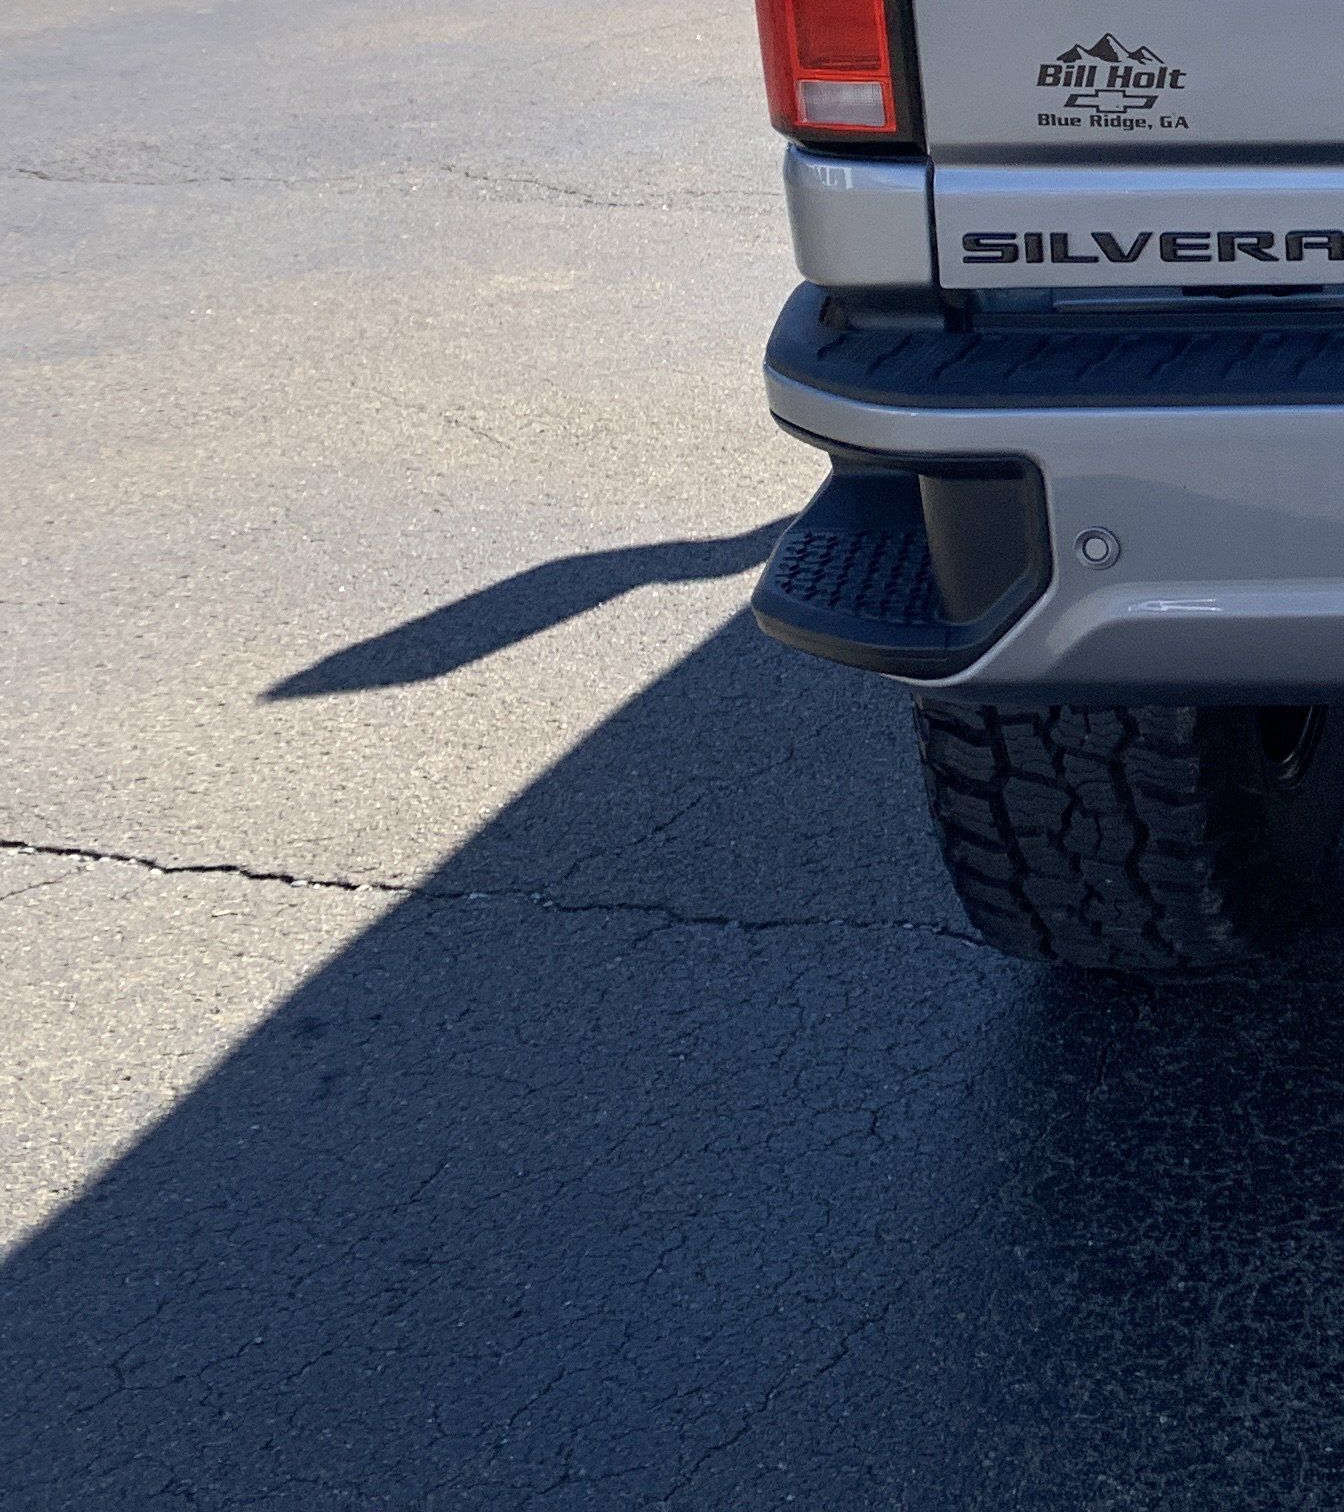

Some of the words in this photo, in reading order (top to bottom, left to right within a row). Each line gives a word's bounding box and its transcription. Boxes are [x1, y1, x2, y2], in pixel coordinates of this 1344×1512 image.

[1036, 63, 1097, 88] Bill
[1106, 65, 1187, 89] Holt
[1037, 113, 1082, 127] Blue
[1090, 114, 1152, 131] Ridge,
[1160, 115, 1189, 129] GA
